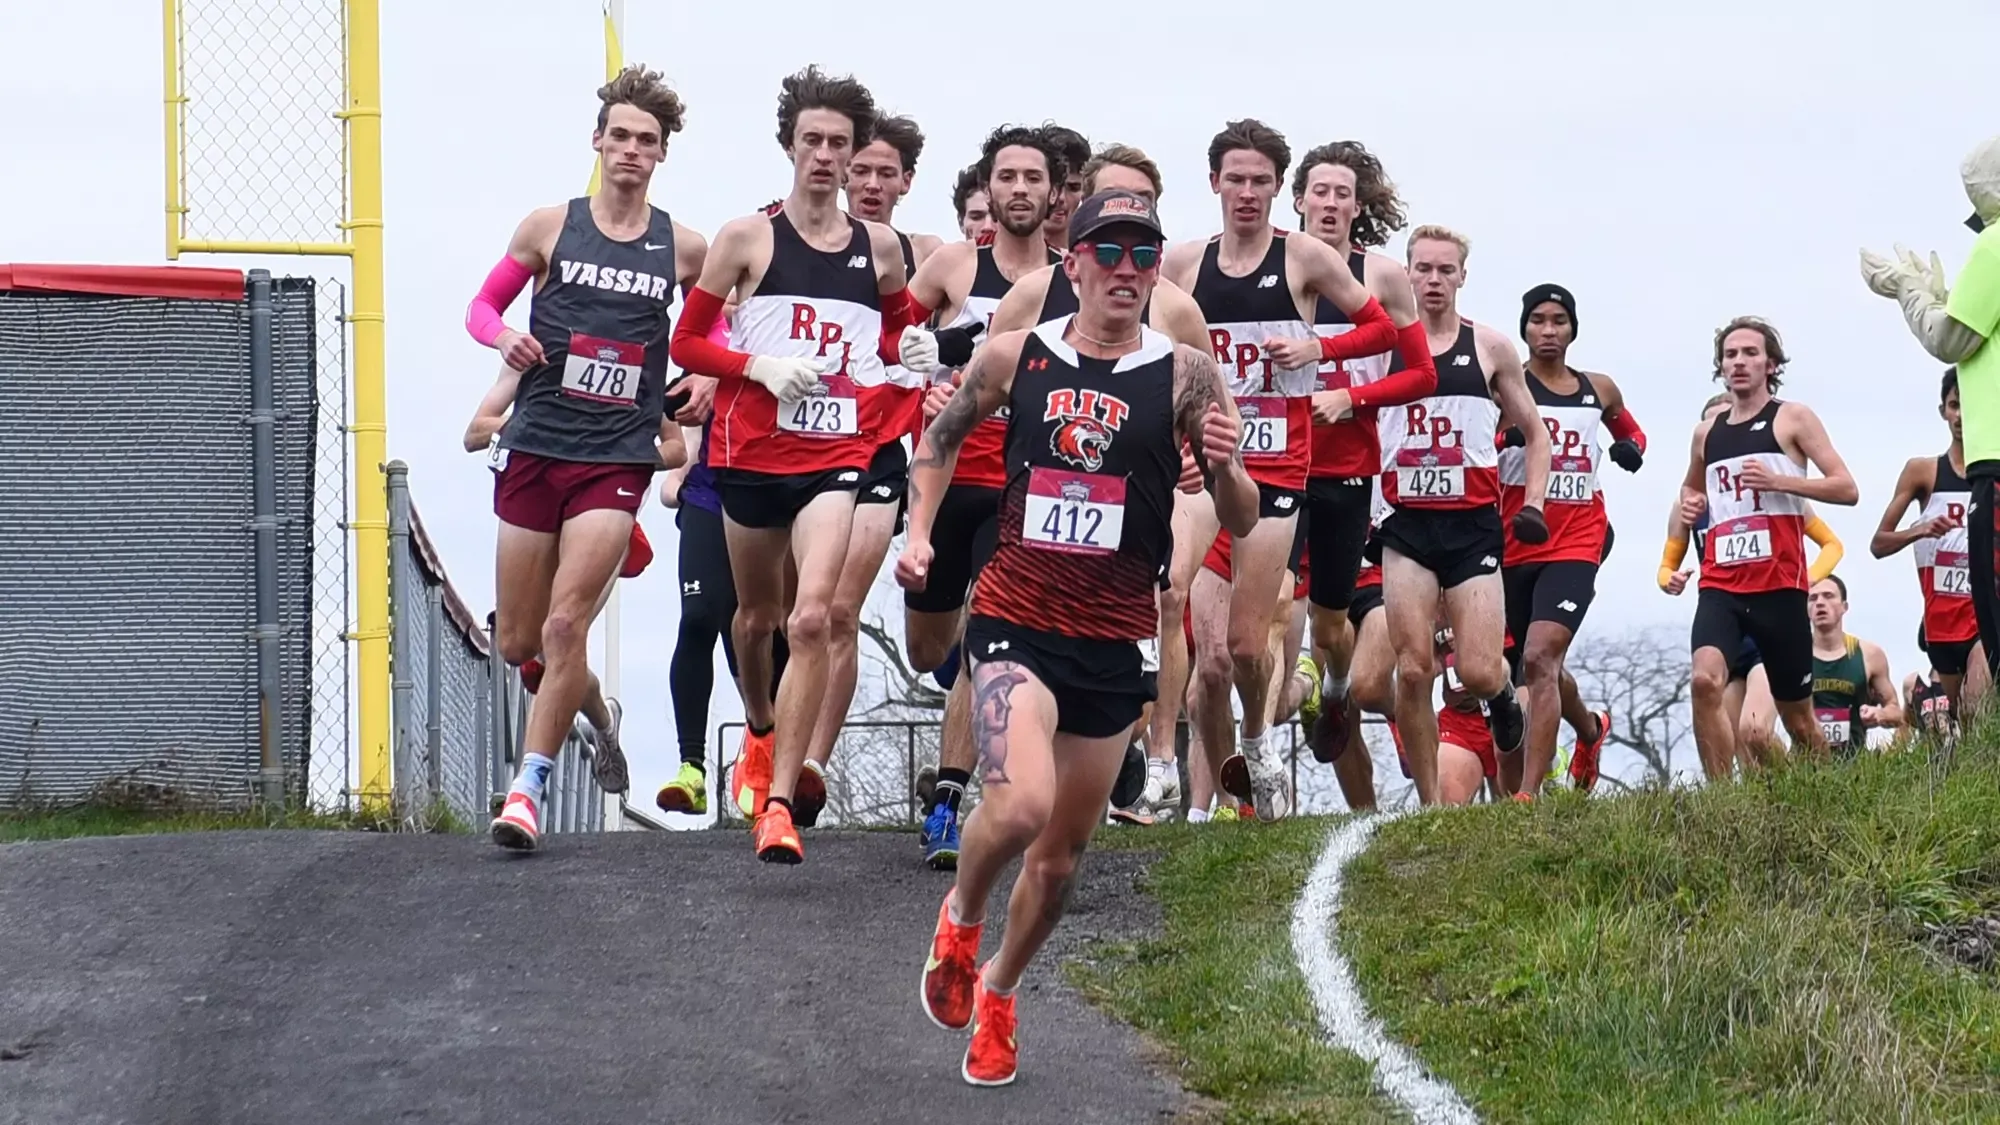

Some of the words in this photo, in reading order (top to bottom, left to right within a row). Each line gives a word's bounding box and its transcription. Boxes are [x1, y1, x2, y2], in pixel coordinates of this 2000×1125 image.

[560, 260, 668, 300] VASSAR
[1257, 274, 1279, 289] NB
[789, 302, 853, 376] RPI
[1208, 328, 1275, 393] RPI
[577, 363, 627, 396] 478
[792, 400, 842, 432] 423
[1043, 388, 1130, 432] RIT
[1242, 420, 1273, 450] 26
[1406, 403, 1465, 452] RPI
[1409, 469, 1452, 497] 425
[1550, 475, 1587, 499] 436
[1274, 496, 1294, 509] NB
[1041, 504, 1103, 546] 412
[1725, 534, 1761, 560] 424
[1943, 569, 1971, 593] 42
[1823, 724, 1842, 741] 66
